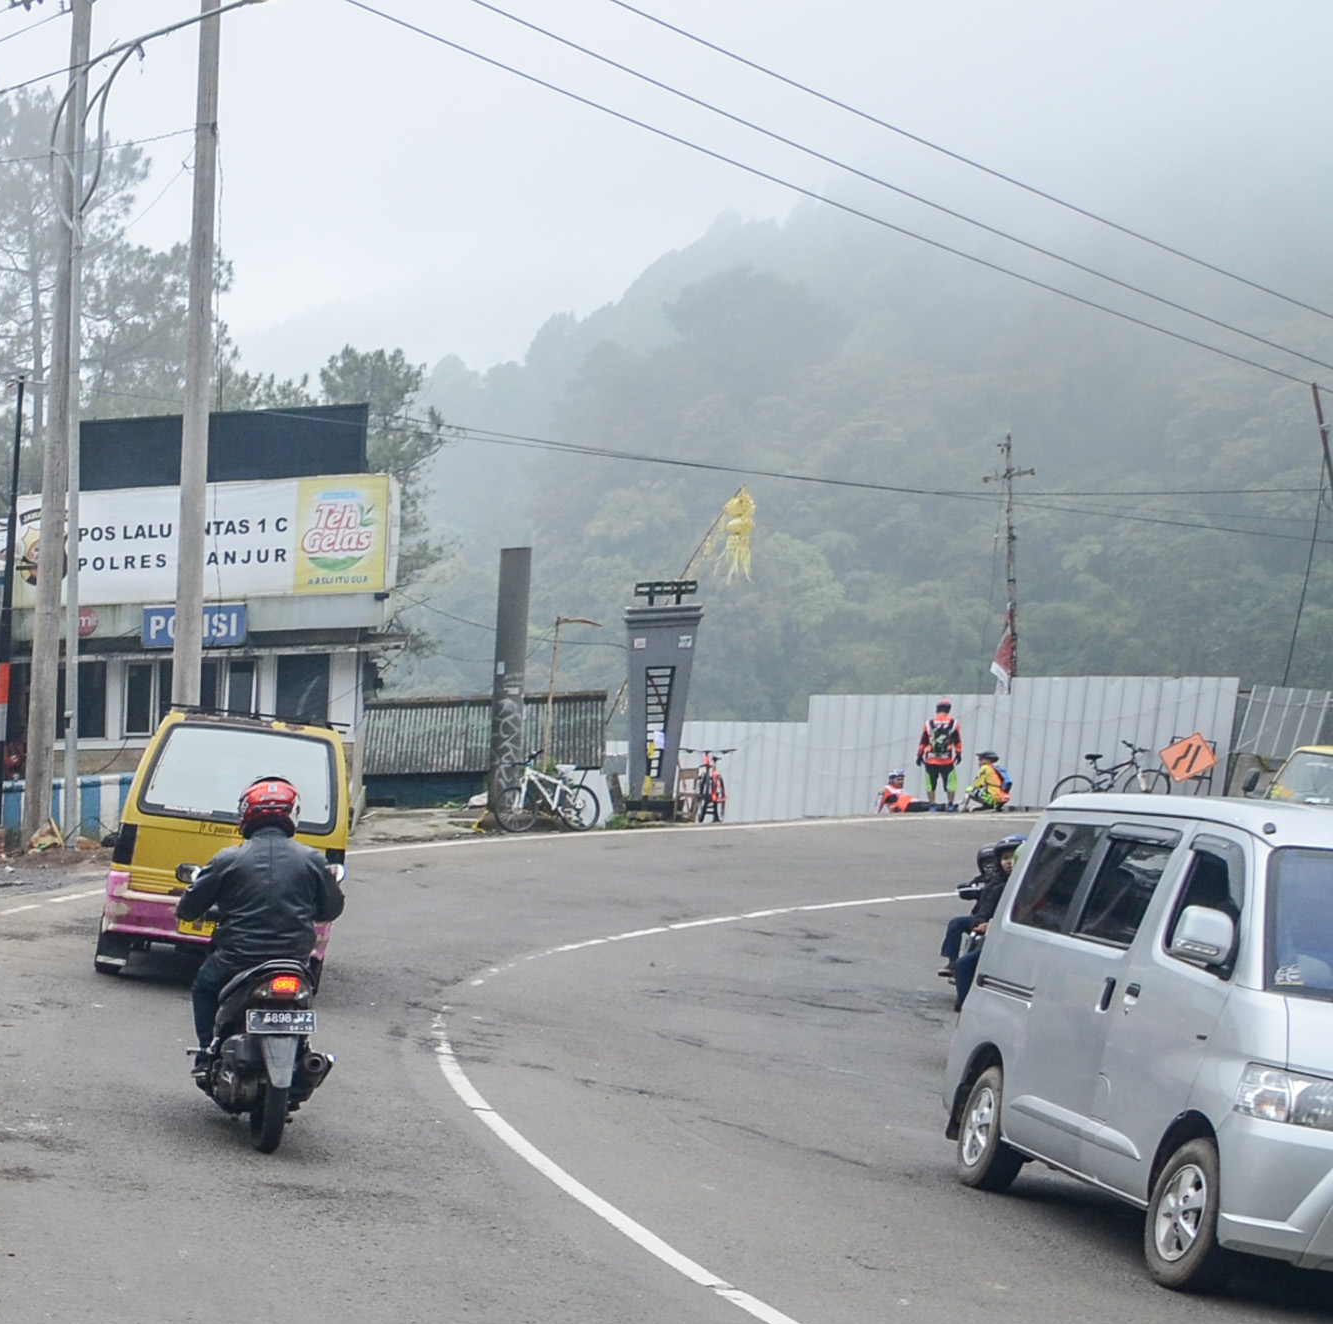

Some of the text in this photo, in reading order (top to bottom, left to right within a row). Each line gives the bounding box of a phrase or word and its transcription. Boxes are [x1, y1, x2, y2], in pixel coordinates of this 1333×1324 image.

[78, 517, 288, 541] POS LALU NTAS 1 C
[315, 503, 359, 531] Teh
[301, 528, 373, 554] Gelas
[78, 548, 287, 571] POLRES ANJUR
[150, 612, 237, 639] POISI
[250, 1012, 257, 1022] F
